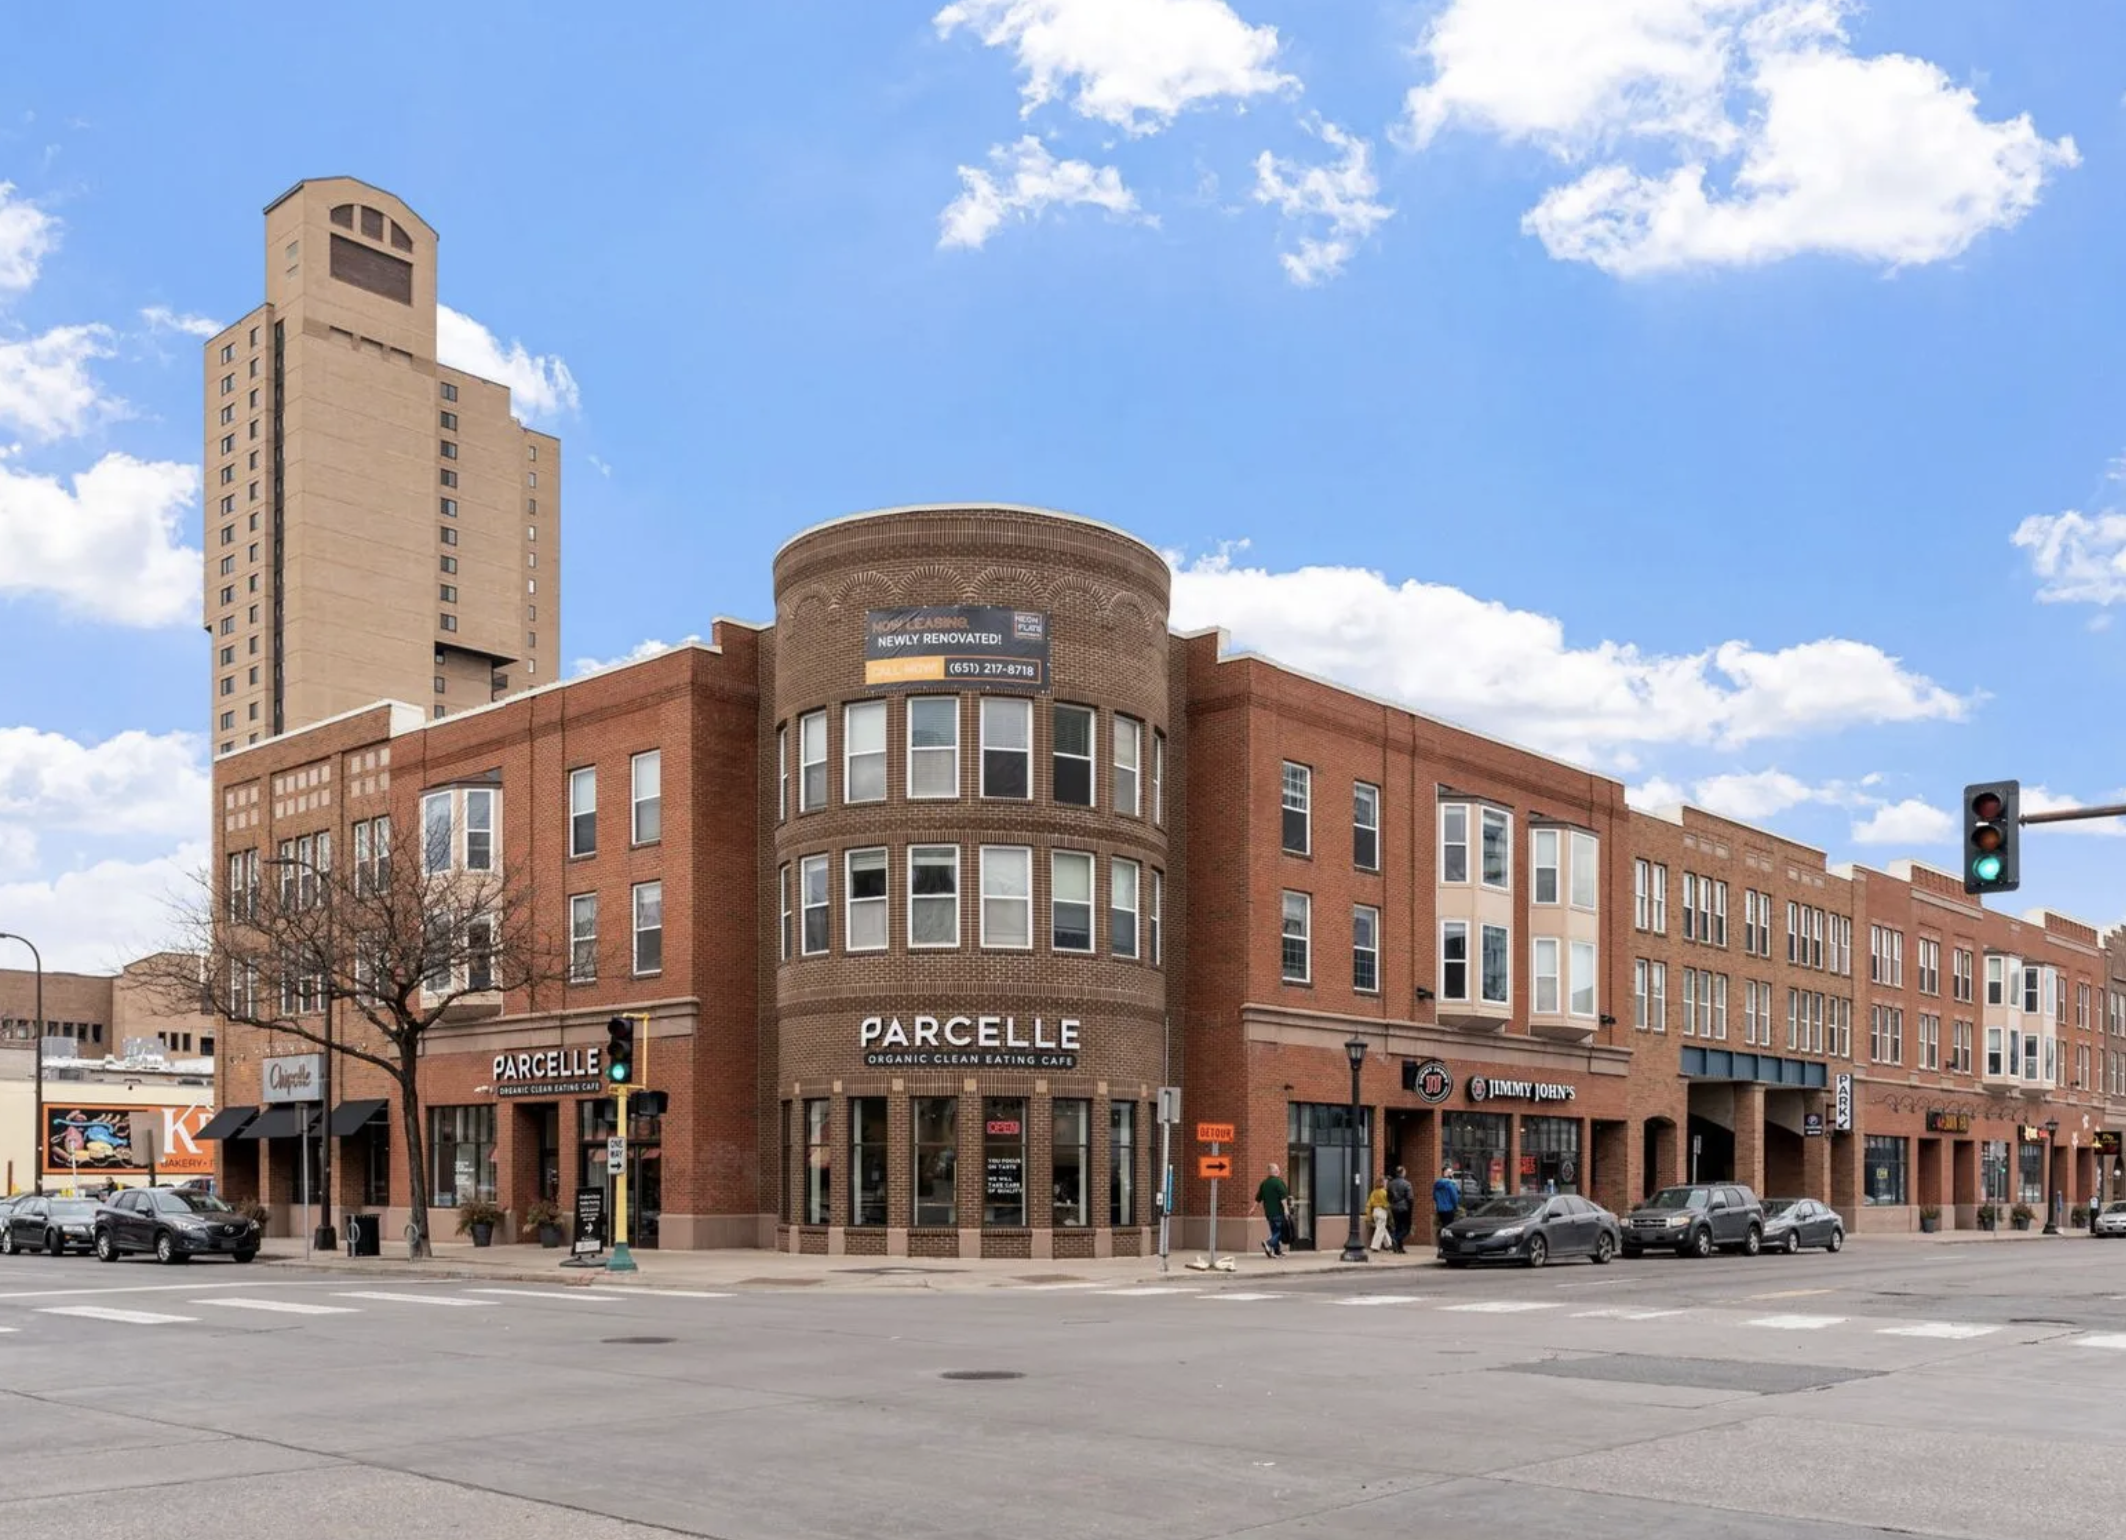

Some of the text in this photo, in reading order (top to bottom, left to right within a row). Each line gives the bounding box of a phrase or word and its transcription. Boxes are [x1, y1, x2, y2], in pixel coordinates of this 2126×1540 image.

[878, 632, 1002, 648] NEWLY RENOVATED!
[950, 662, 1034, 677] (651) 217-8718
[860, 1015, 1081, 1050] PARCELLE
[493, 1047, 600, 1081] PARCELLE
[868, 1053, 1074, 1067] ORGANIC CLEAN EATING CAFE
[530, 1085, 553, 1094] CLEAN
[554, 1083, 580, 1093] EATING
[1488, 1078, 1532, 1099] JIMMY
[1534, 1081, 1577, 1102] JOHN'S
[1838, 1075, 1849, 1117] PARK
[989, 1122, 1018, 1133] OPEN
[1199, 1125, 1232, 1139] DETOUR
[610, 1138, 624, 1148] ONE
[610, 1149, 624, 1159] WAY
